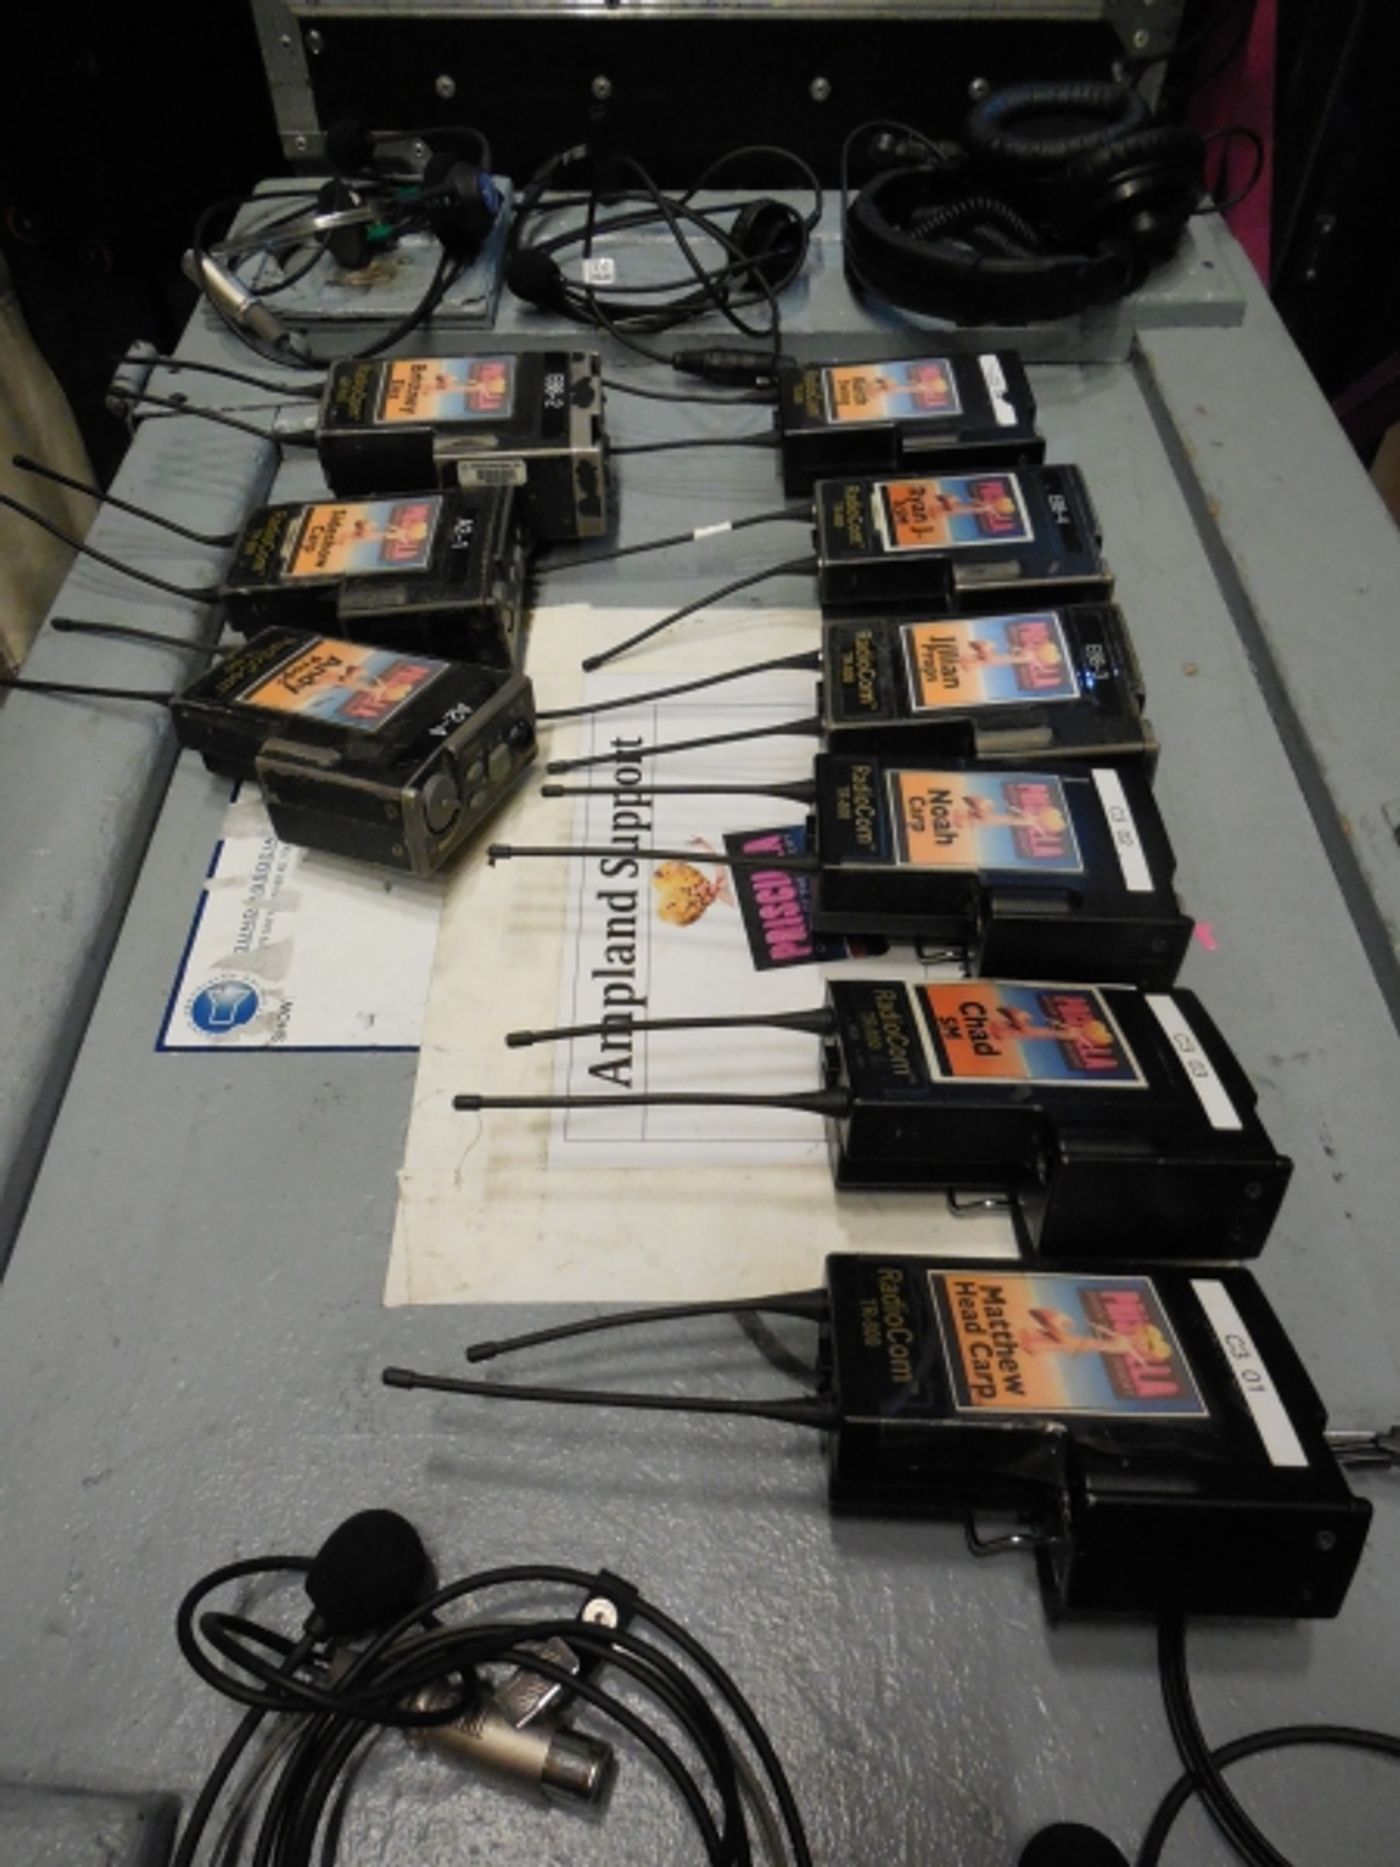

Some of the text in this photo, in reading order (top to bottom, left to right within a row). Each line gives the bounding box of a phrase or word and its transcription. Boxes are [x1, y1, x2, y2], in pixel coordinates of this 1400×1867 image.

[301, 525, 326, 553] Carp
[314, 509, 347, 568] Sideshow
[451, 518, 475, 549] A2-1
[282, 655, 344, 695] Andy
[852, 630, 878, 704] RadioCom
[918, 644, 939, 683] Props
[928, 635, 961, 690] Jillian
[851, 765, 878, 846] RadioCom
[906, 796, 928, 833] Carp
[926, 788, 959, 846] Noah
[1107, 805, 1127, 823] C3
[587, 736, 653, 1089] Ampland Support
[741, 834, 814, 961] PRISCILA
[873, 988, 912, 1077] RadioCom
[937, 1015, 963, 1040] SM
[957, 1001, 1001, 1058] Chad
[1172, 1032, 1196, 1054] C3
[877, 1266, 915, 1384] RadioCom
[953, 1281, 1000, 1400] Head Carp
[977, 1284, 1026, 1397] Matthew
[1224, 1333, 1266, 1394] C3 01
